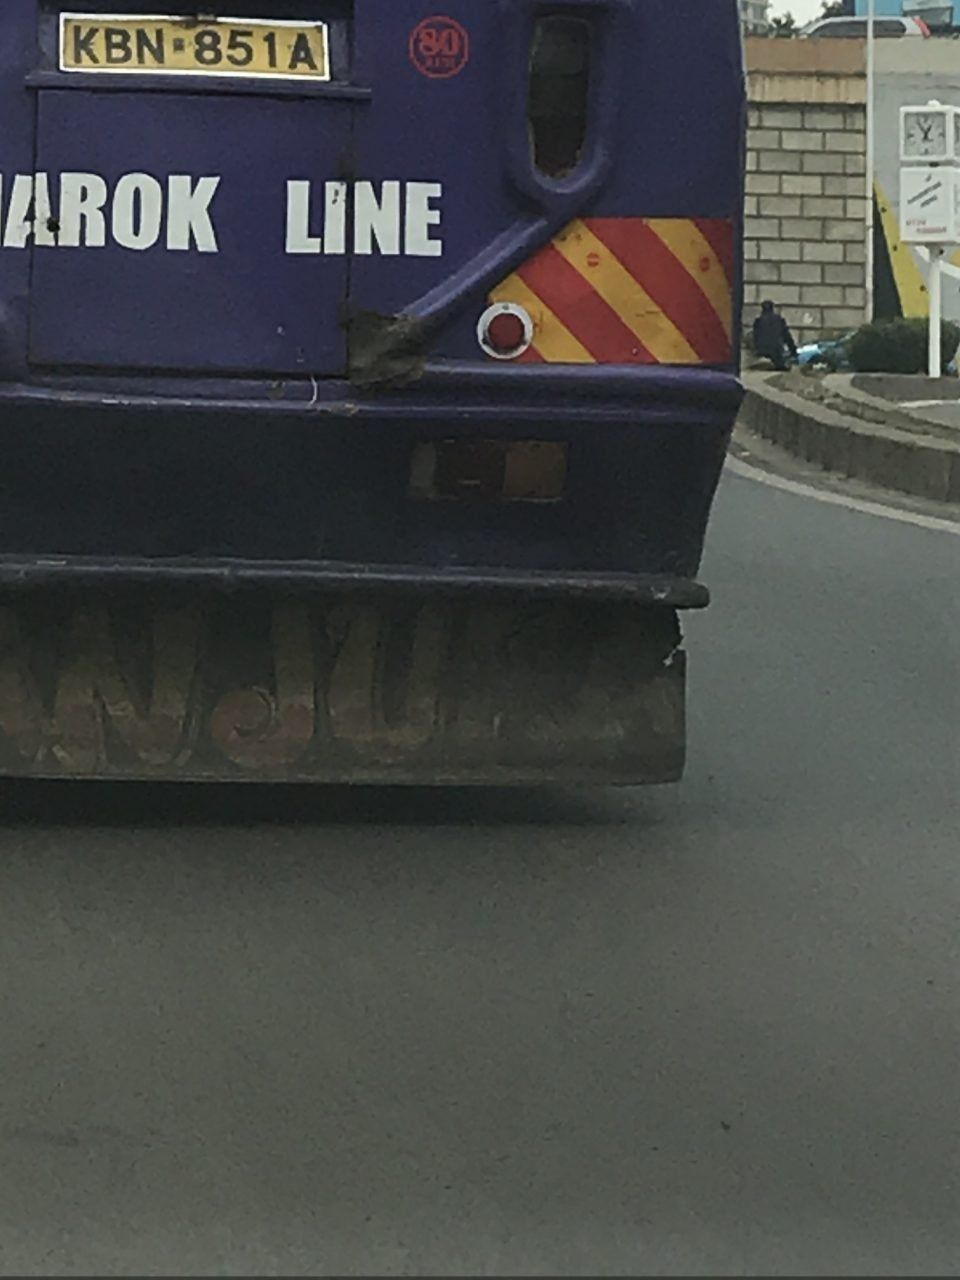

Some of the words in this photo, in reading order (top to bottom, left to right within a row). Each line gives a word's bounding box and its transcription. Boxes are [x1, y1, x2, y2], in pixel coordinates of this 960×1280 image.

[73, 24, 165, 65] KBN
[194, 28, 318, 70] 851A
[419, 28, 460, 55] 80
[285, 179, 442, 256] LINE
